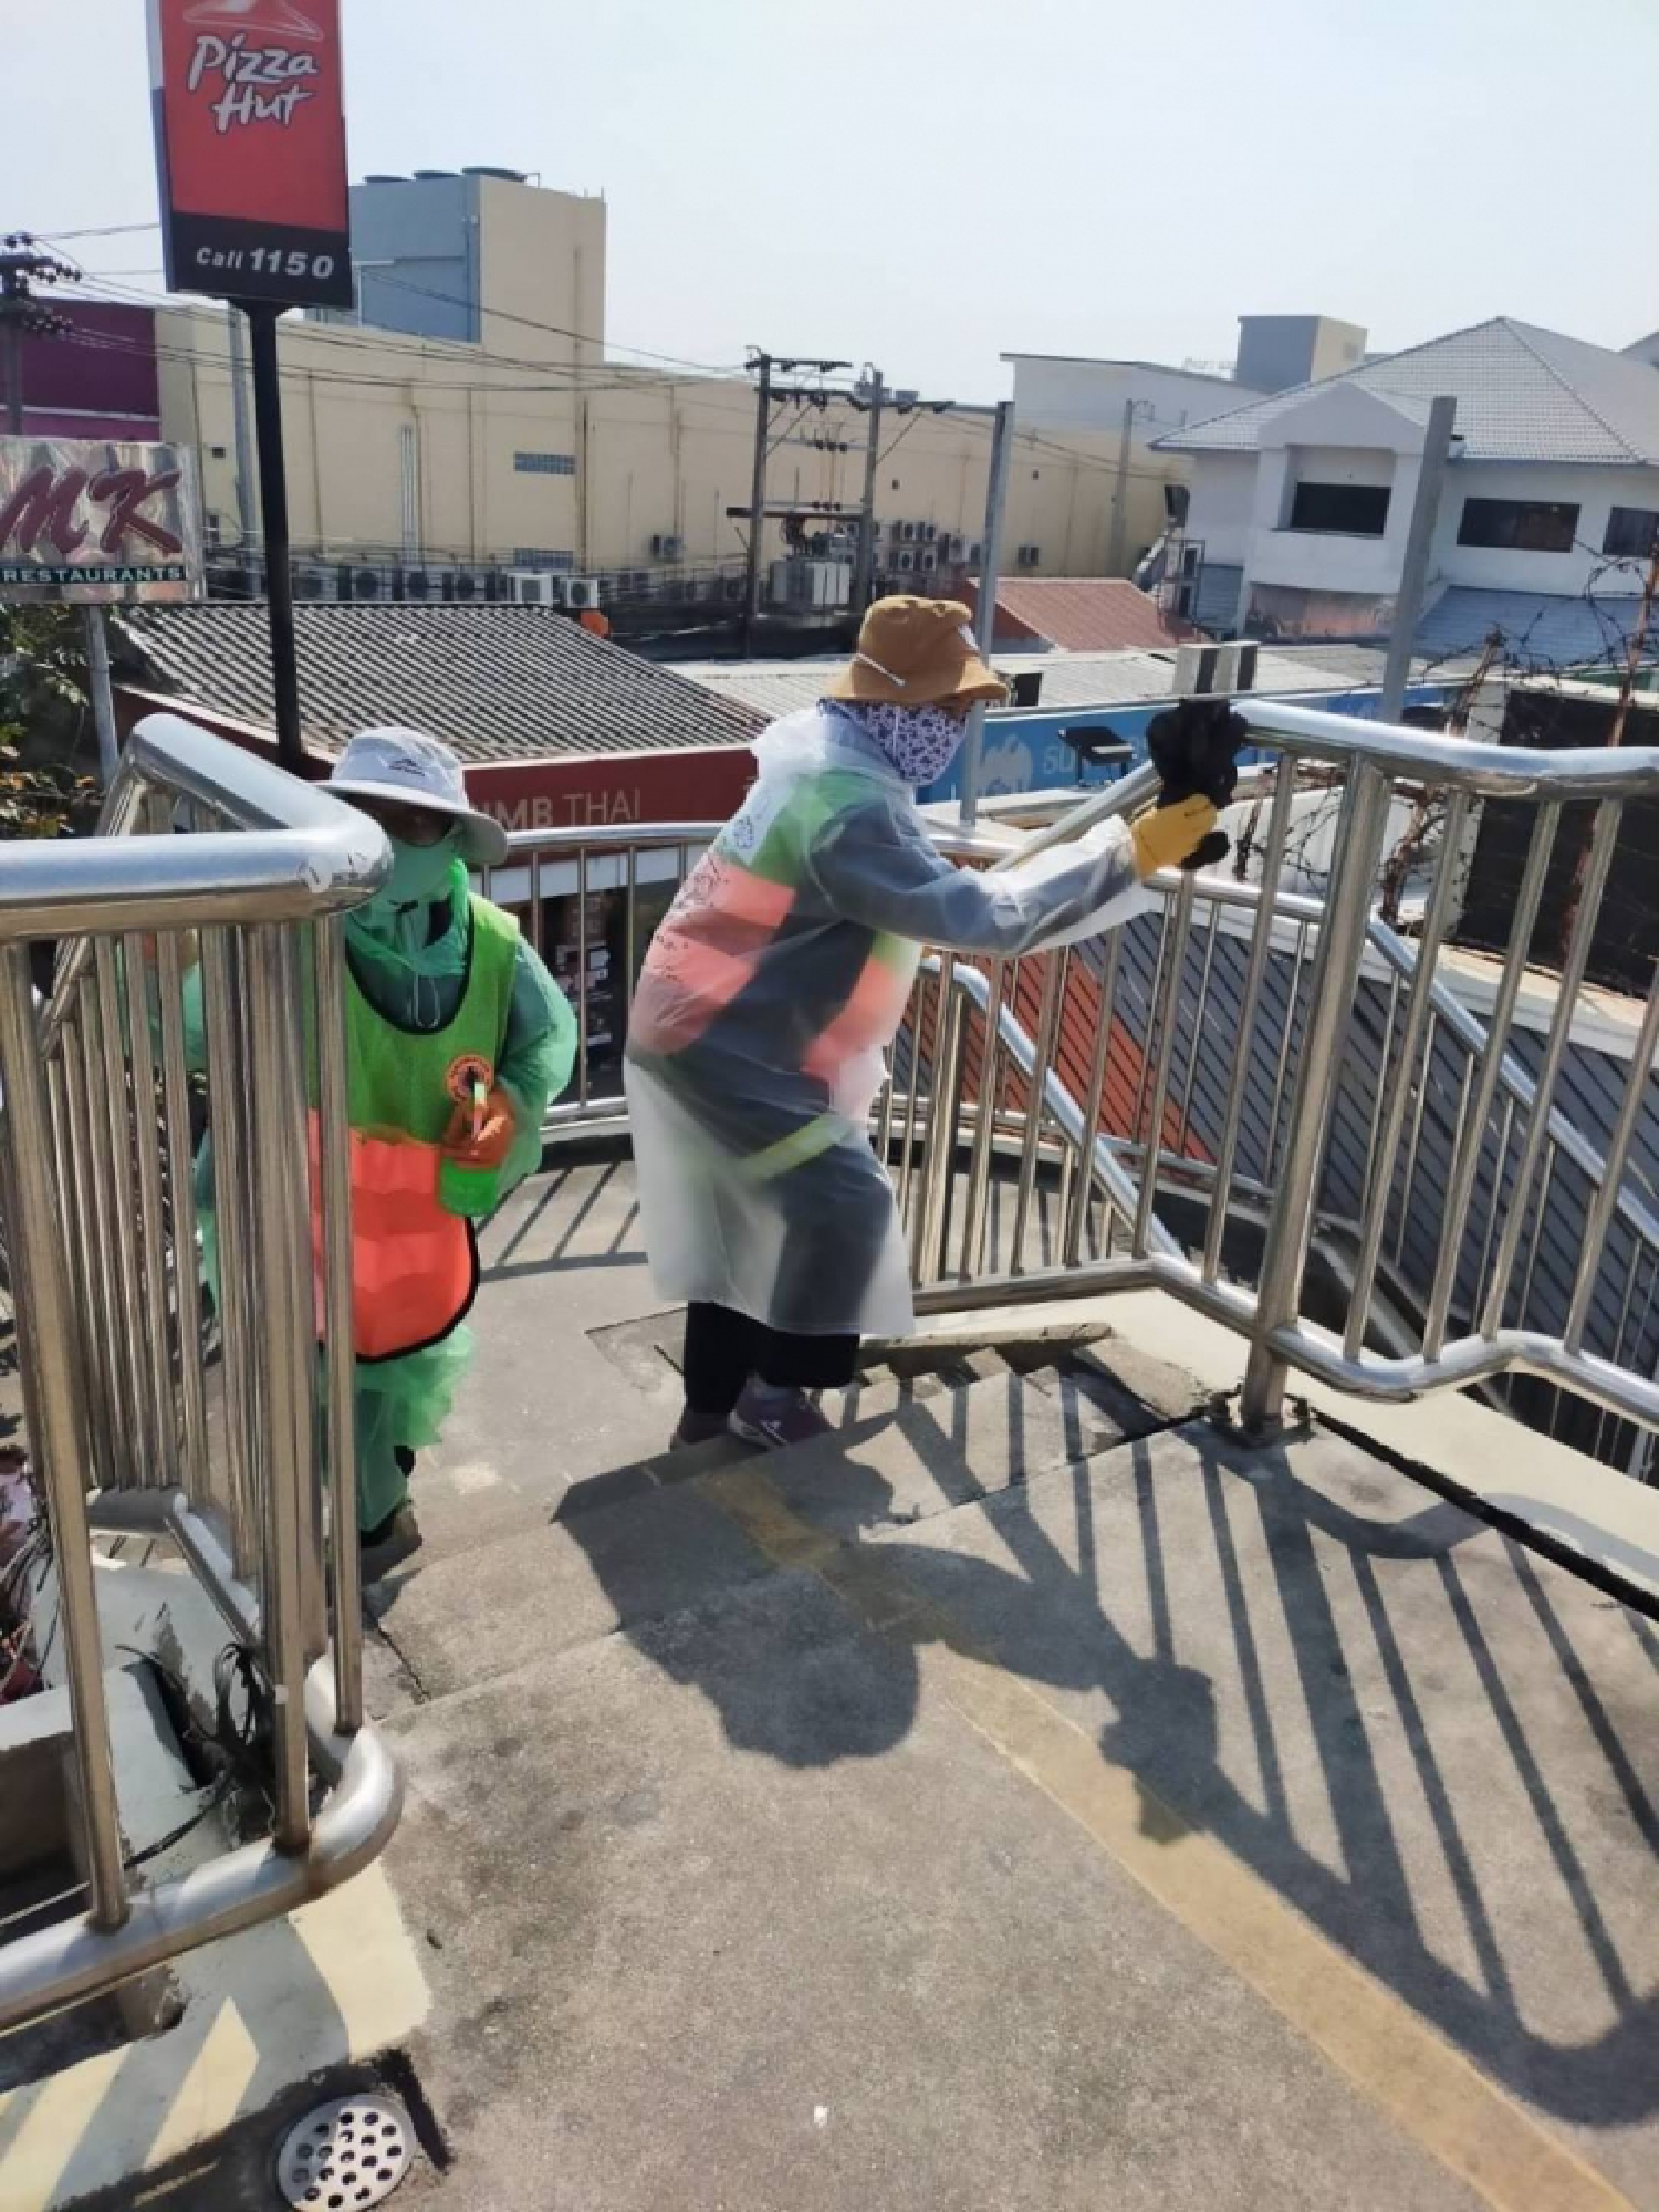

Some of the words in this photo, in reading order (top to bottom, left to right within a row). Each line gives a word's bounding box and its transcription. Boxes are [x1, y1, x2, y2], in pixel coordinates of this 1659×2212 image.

[188, 32, 318, 92] Pizza
[212, 83, 314, 133] Hut
[196, 246, 244, 269] Call
[250, 248, 335, 280] 1150
[0, 466, 182, 557] MK
[2, 566, 182, 581] RESTAURANTS
[562, 787, 640, 827] THAI
